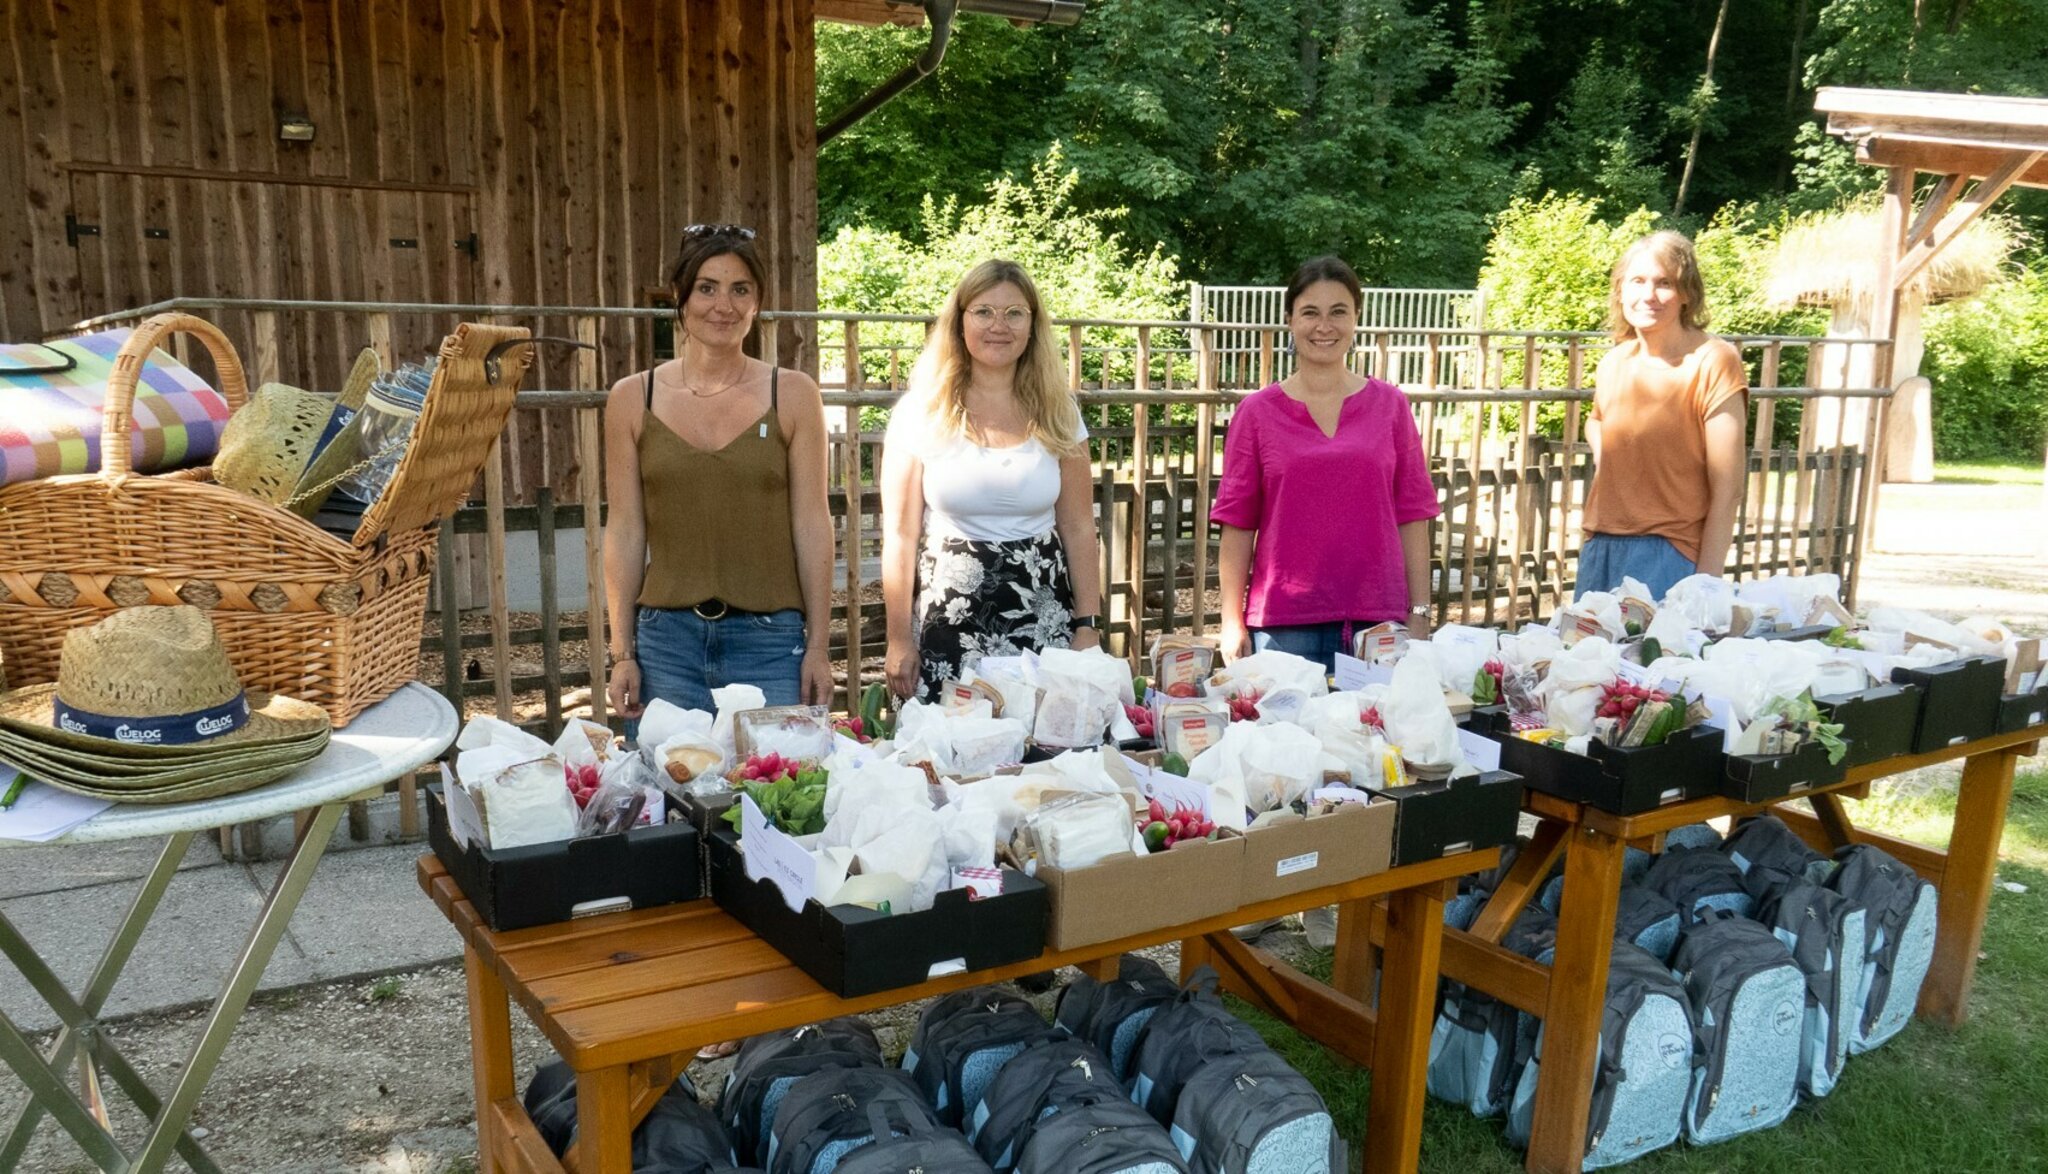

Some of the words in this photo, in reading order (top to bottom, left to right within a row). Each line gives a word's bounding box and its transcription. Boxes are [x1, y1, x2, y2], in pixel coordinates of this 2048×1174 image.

[62, 718, 87, 733] WELOG
[199, 714, 232, 731] WELOG
[119, 728, 161, 739] WELOG
